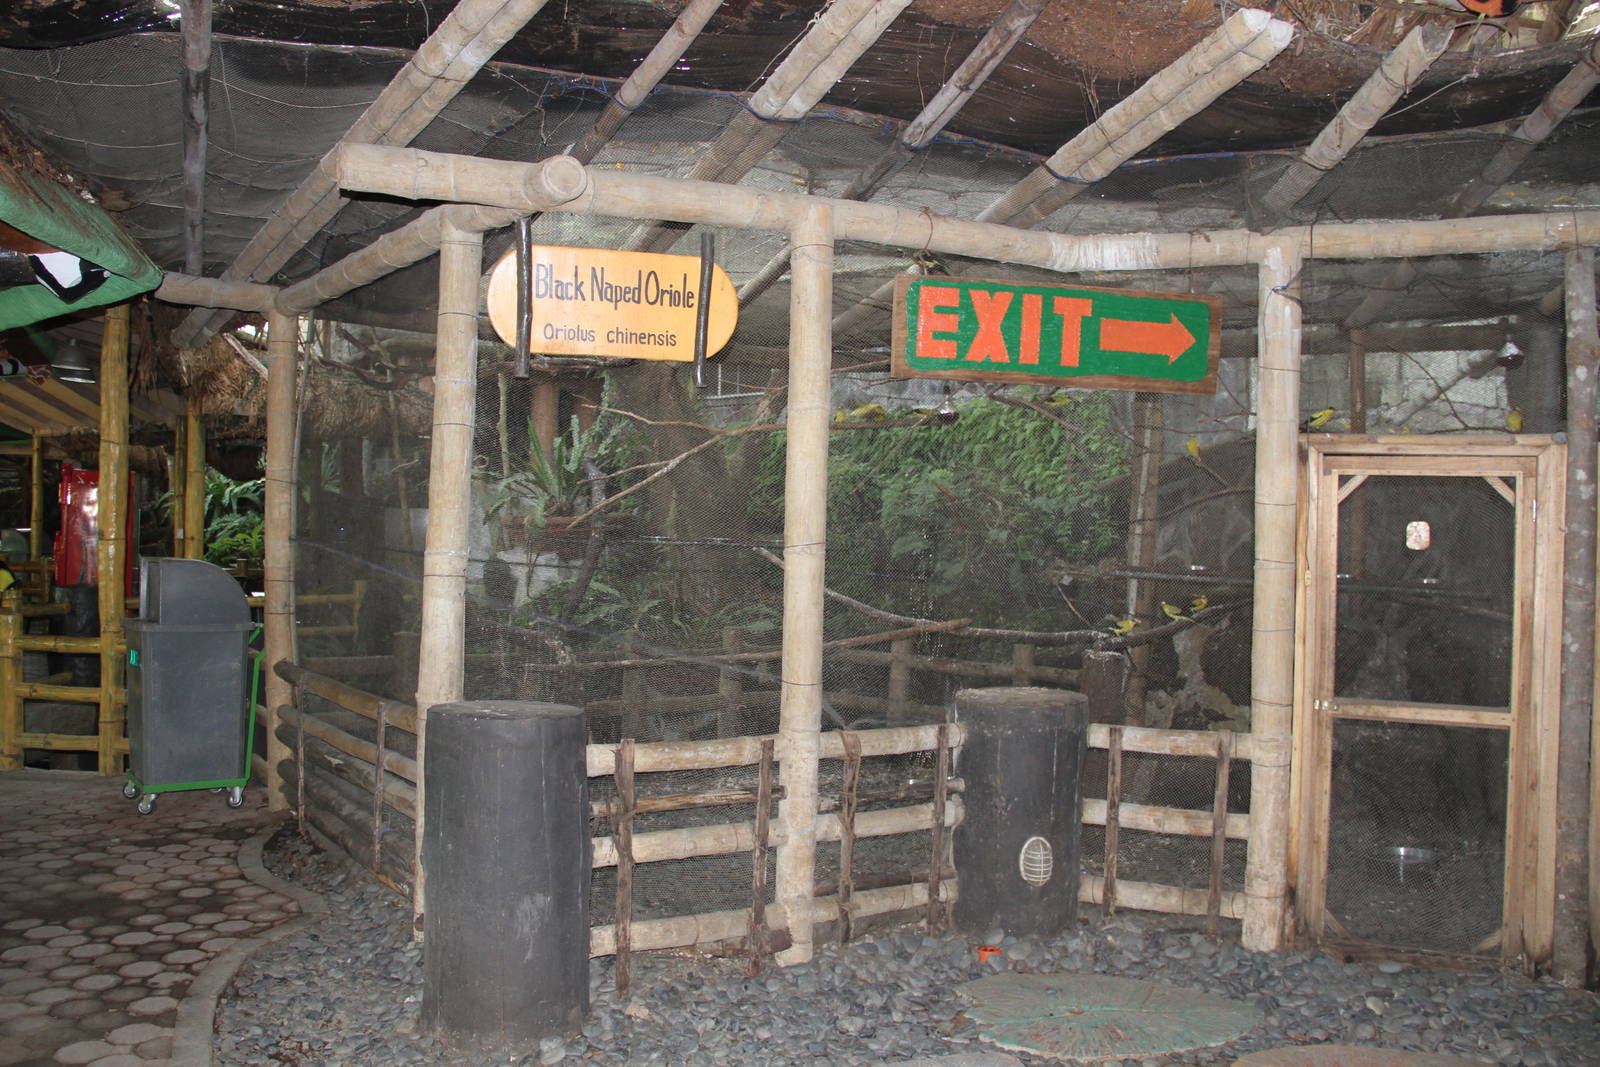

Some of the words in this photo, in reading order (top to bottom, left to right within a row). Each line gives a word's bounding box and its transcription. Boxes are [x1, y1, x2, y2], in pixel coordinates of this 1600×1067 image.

[535, 263, 586, 302] Black
[591, 266, 642, 310] Naped
[645, 270, 695, 309] Oriole
[543, 322, 596, 342] Oriolus
[606, 327, 677, 346] chinensis
[915, 285, 1093, 367] EXIT
